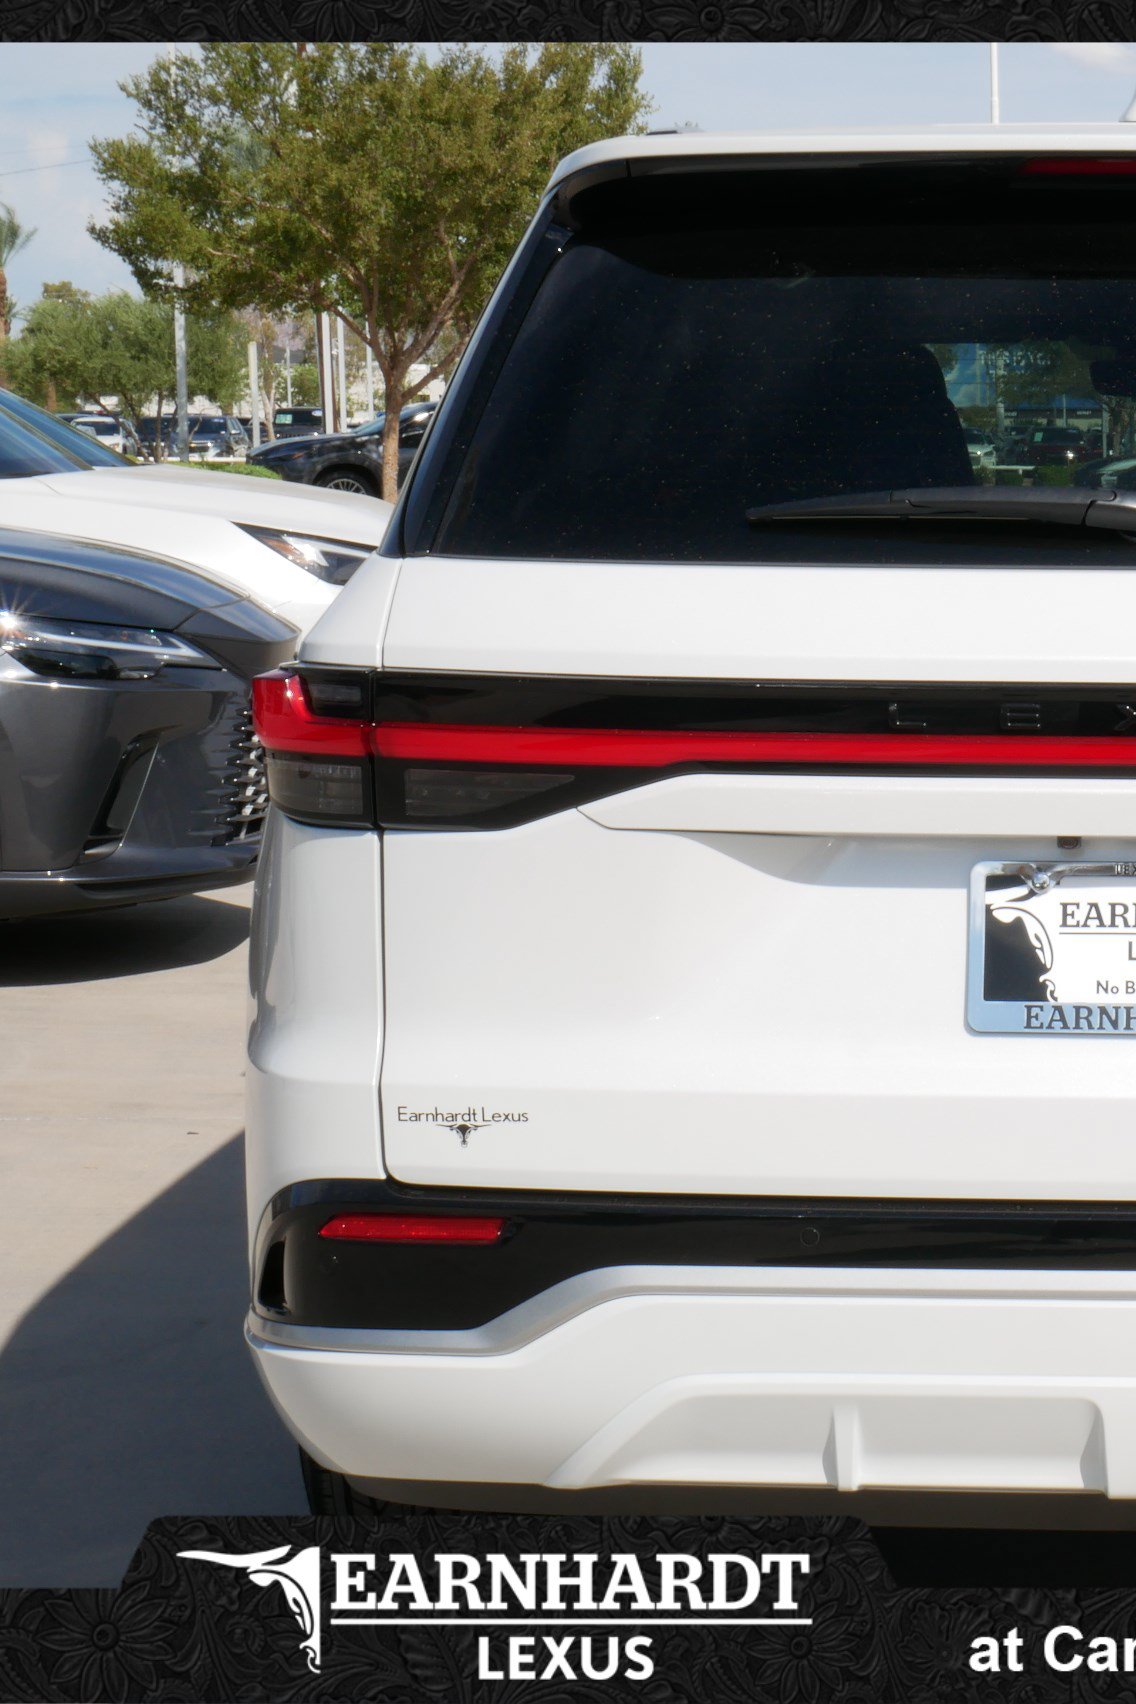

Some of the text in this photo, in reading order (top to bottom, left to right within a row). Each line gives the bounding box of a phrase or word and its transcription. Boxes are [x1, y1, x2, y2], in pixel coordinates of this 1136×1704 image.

[1096, 980, 1120, 995] No
[397, 1106, 529, 1123] Earnhardt Lexus
